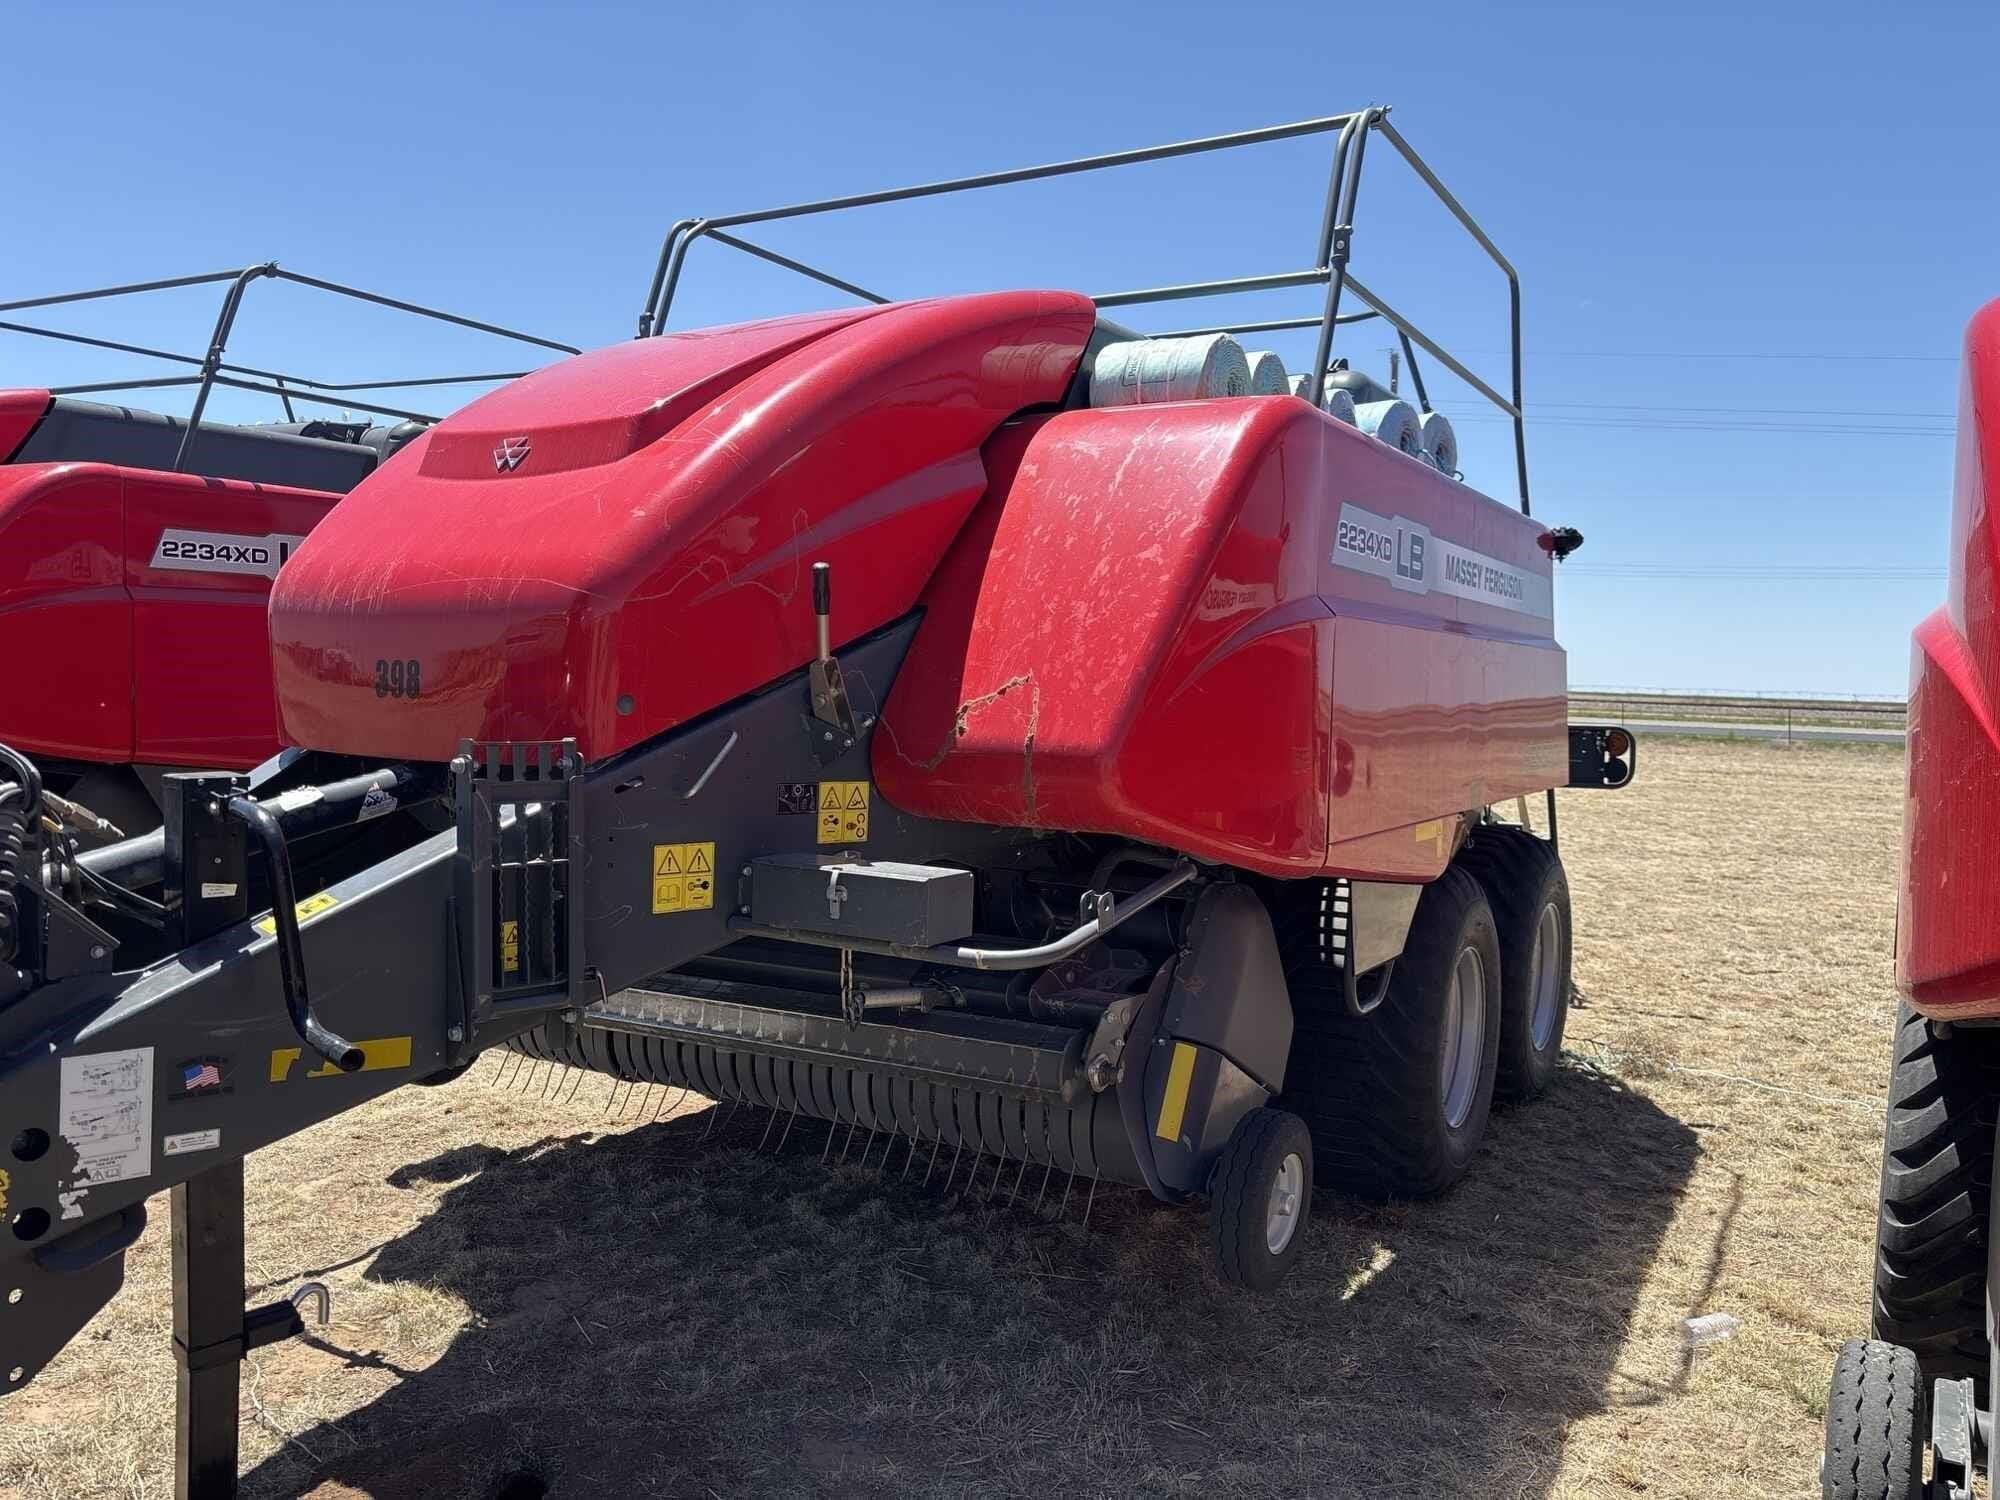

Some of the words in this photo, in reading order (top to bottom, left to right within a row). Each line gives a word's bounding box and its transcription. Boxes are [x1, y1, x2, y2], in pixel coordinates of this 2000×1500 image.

[161, 541, 269, 564] 2234XD
[1338, 521, 1392, 562] 2234XD
[1396, 528, 1425, 581] LB
[1445, 554, 1483, 590] MASSEY
[1484, 566, 1523, 601] FERGUSON
[376, 659, 420, 698] 398
